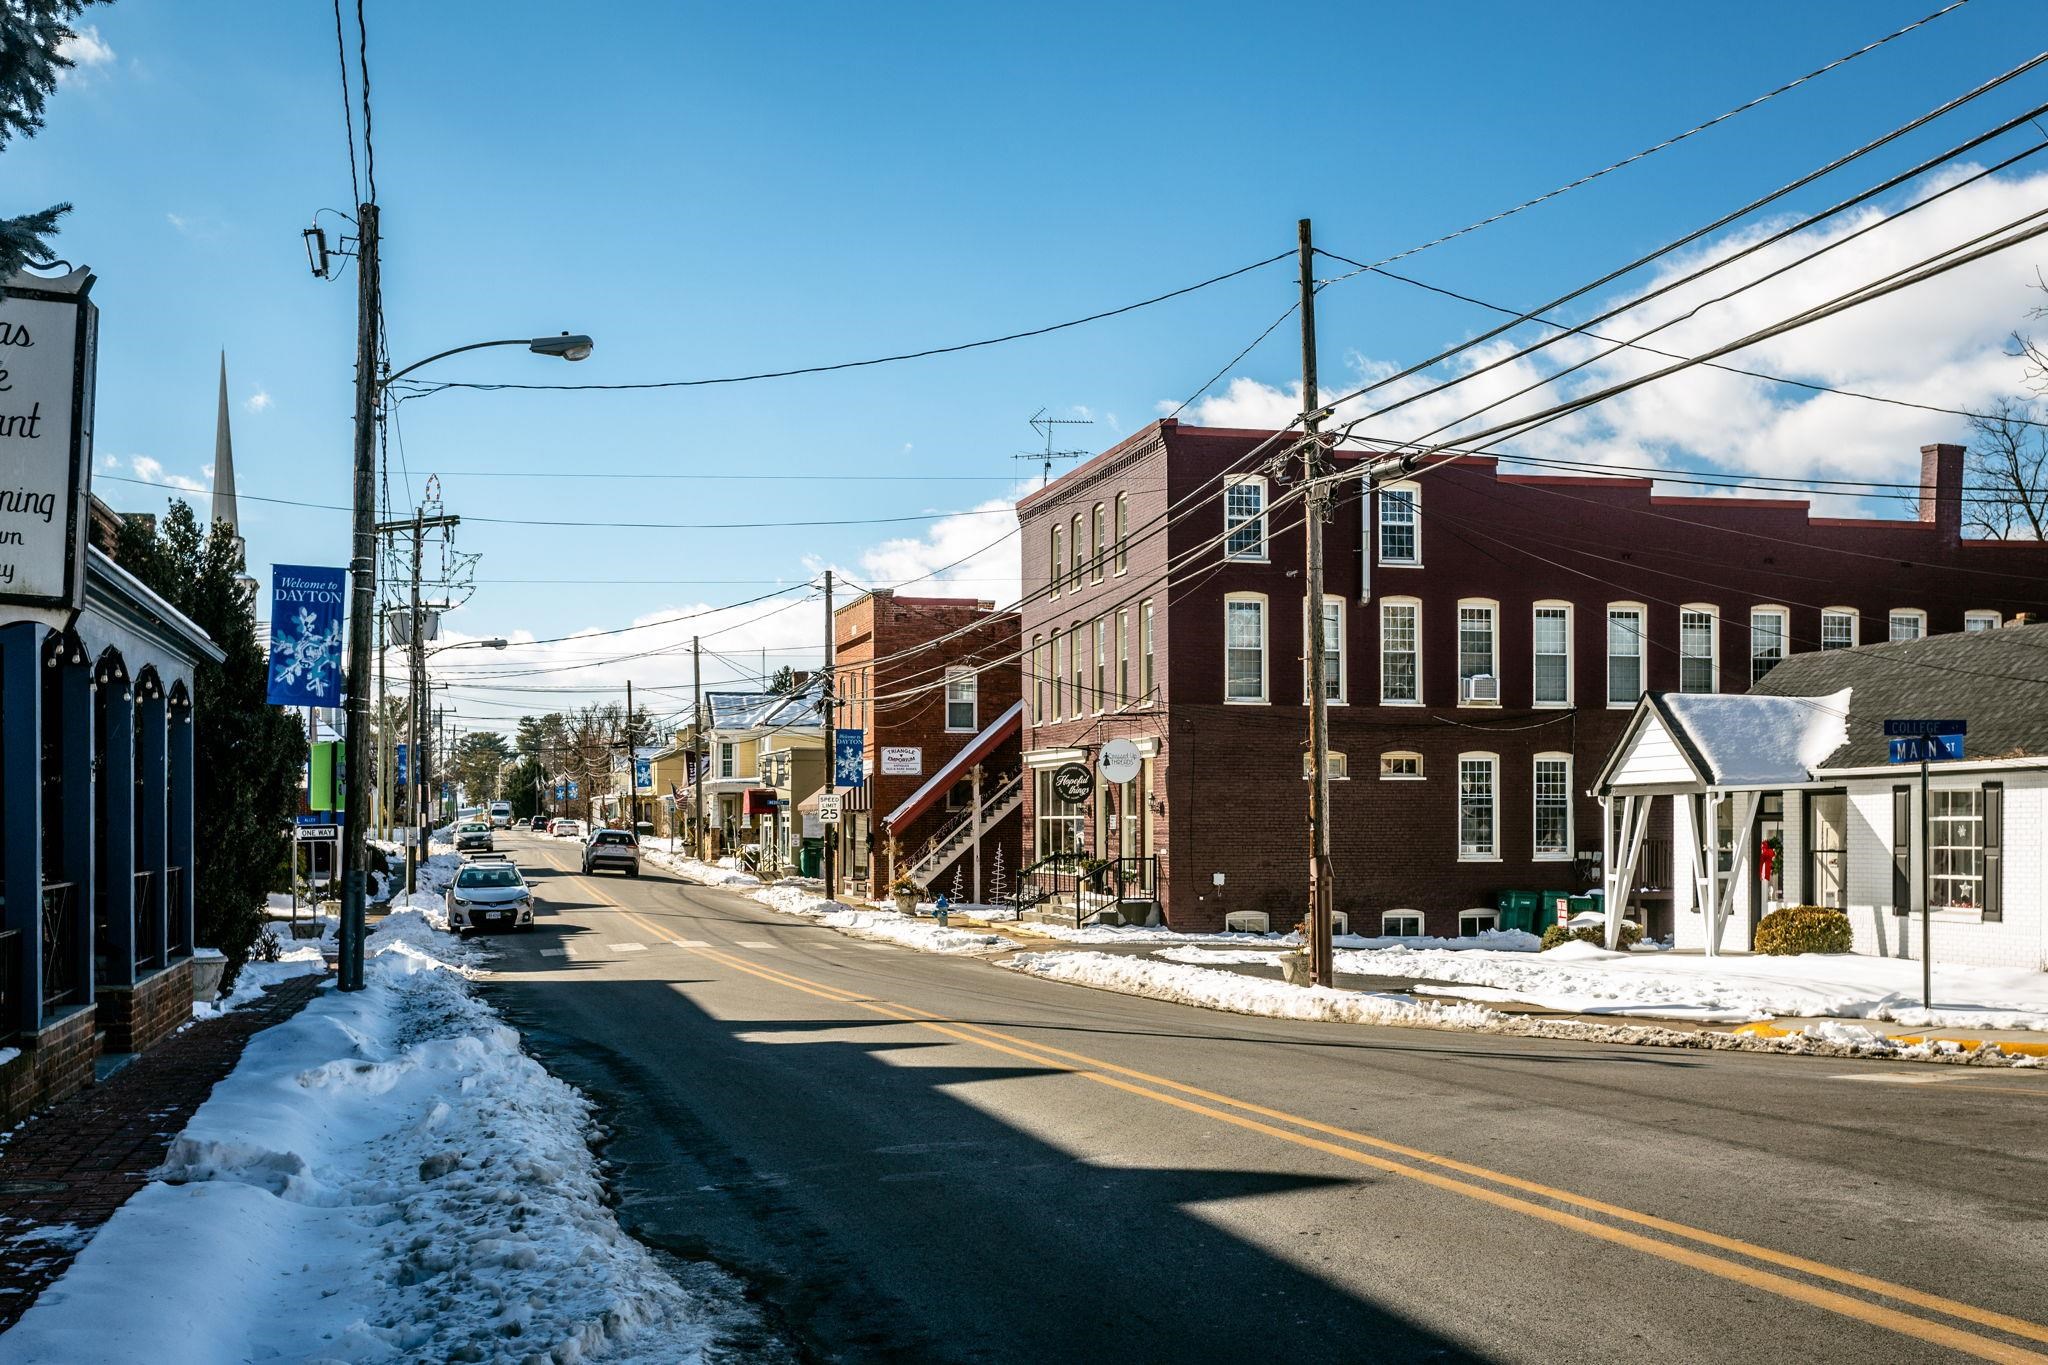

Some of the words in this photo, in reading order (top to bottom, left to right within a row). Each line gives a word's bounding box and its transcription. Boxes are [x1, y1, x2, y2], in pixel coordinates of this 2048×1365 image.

[281, 577, 326, 589] Welcome
[327, 581, 338, 590] to
[274, 588, 343, 604] DAYTON
[1892, 722, 1941, 733] COLLEGE
[1896, 740, 1937, 760] MAIN
[1945, 742, 1956, 753] ST
[1056, 774, 1089, 788] Hopeful
[1068, 785, 1089, 796] things
[820, 809, 838, 819] 25
[302, 829, 315, 837] ONE
[318, 828, 332, 836] WAY
